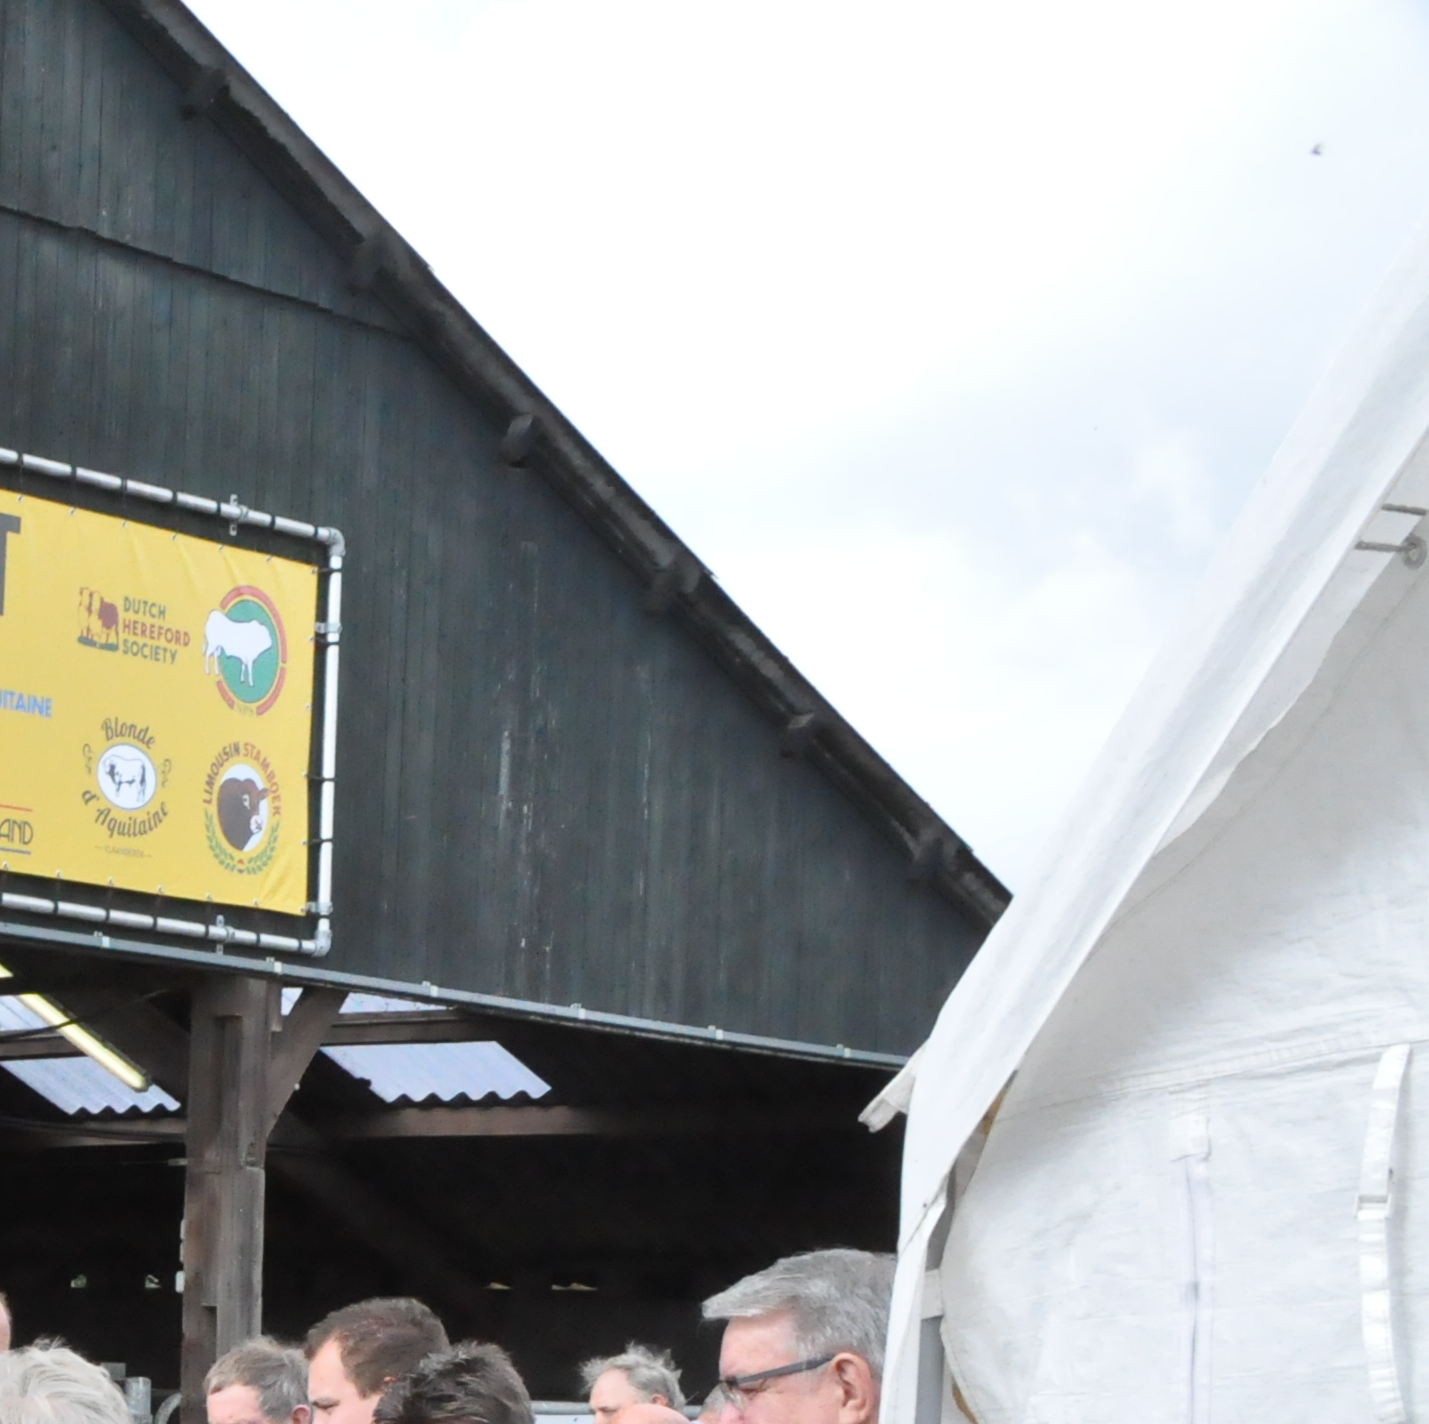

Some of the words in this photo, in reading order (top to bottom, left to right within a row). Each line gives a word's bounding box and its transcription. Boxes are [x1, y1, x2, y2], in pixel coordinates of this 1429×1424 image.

[123, 595, 167, 621] DUTCH
[122, 617, 191, 647] HEREFORD
[122, 638, 178, 666] SOCIETY
[101, 716, 156, 750] Blonde
[202, 740, 241, 806] LIMOUSIN
[242, 740, 283, 818] STAMBOEK
